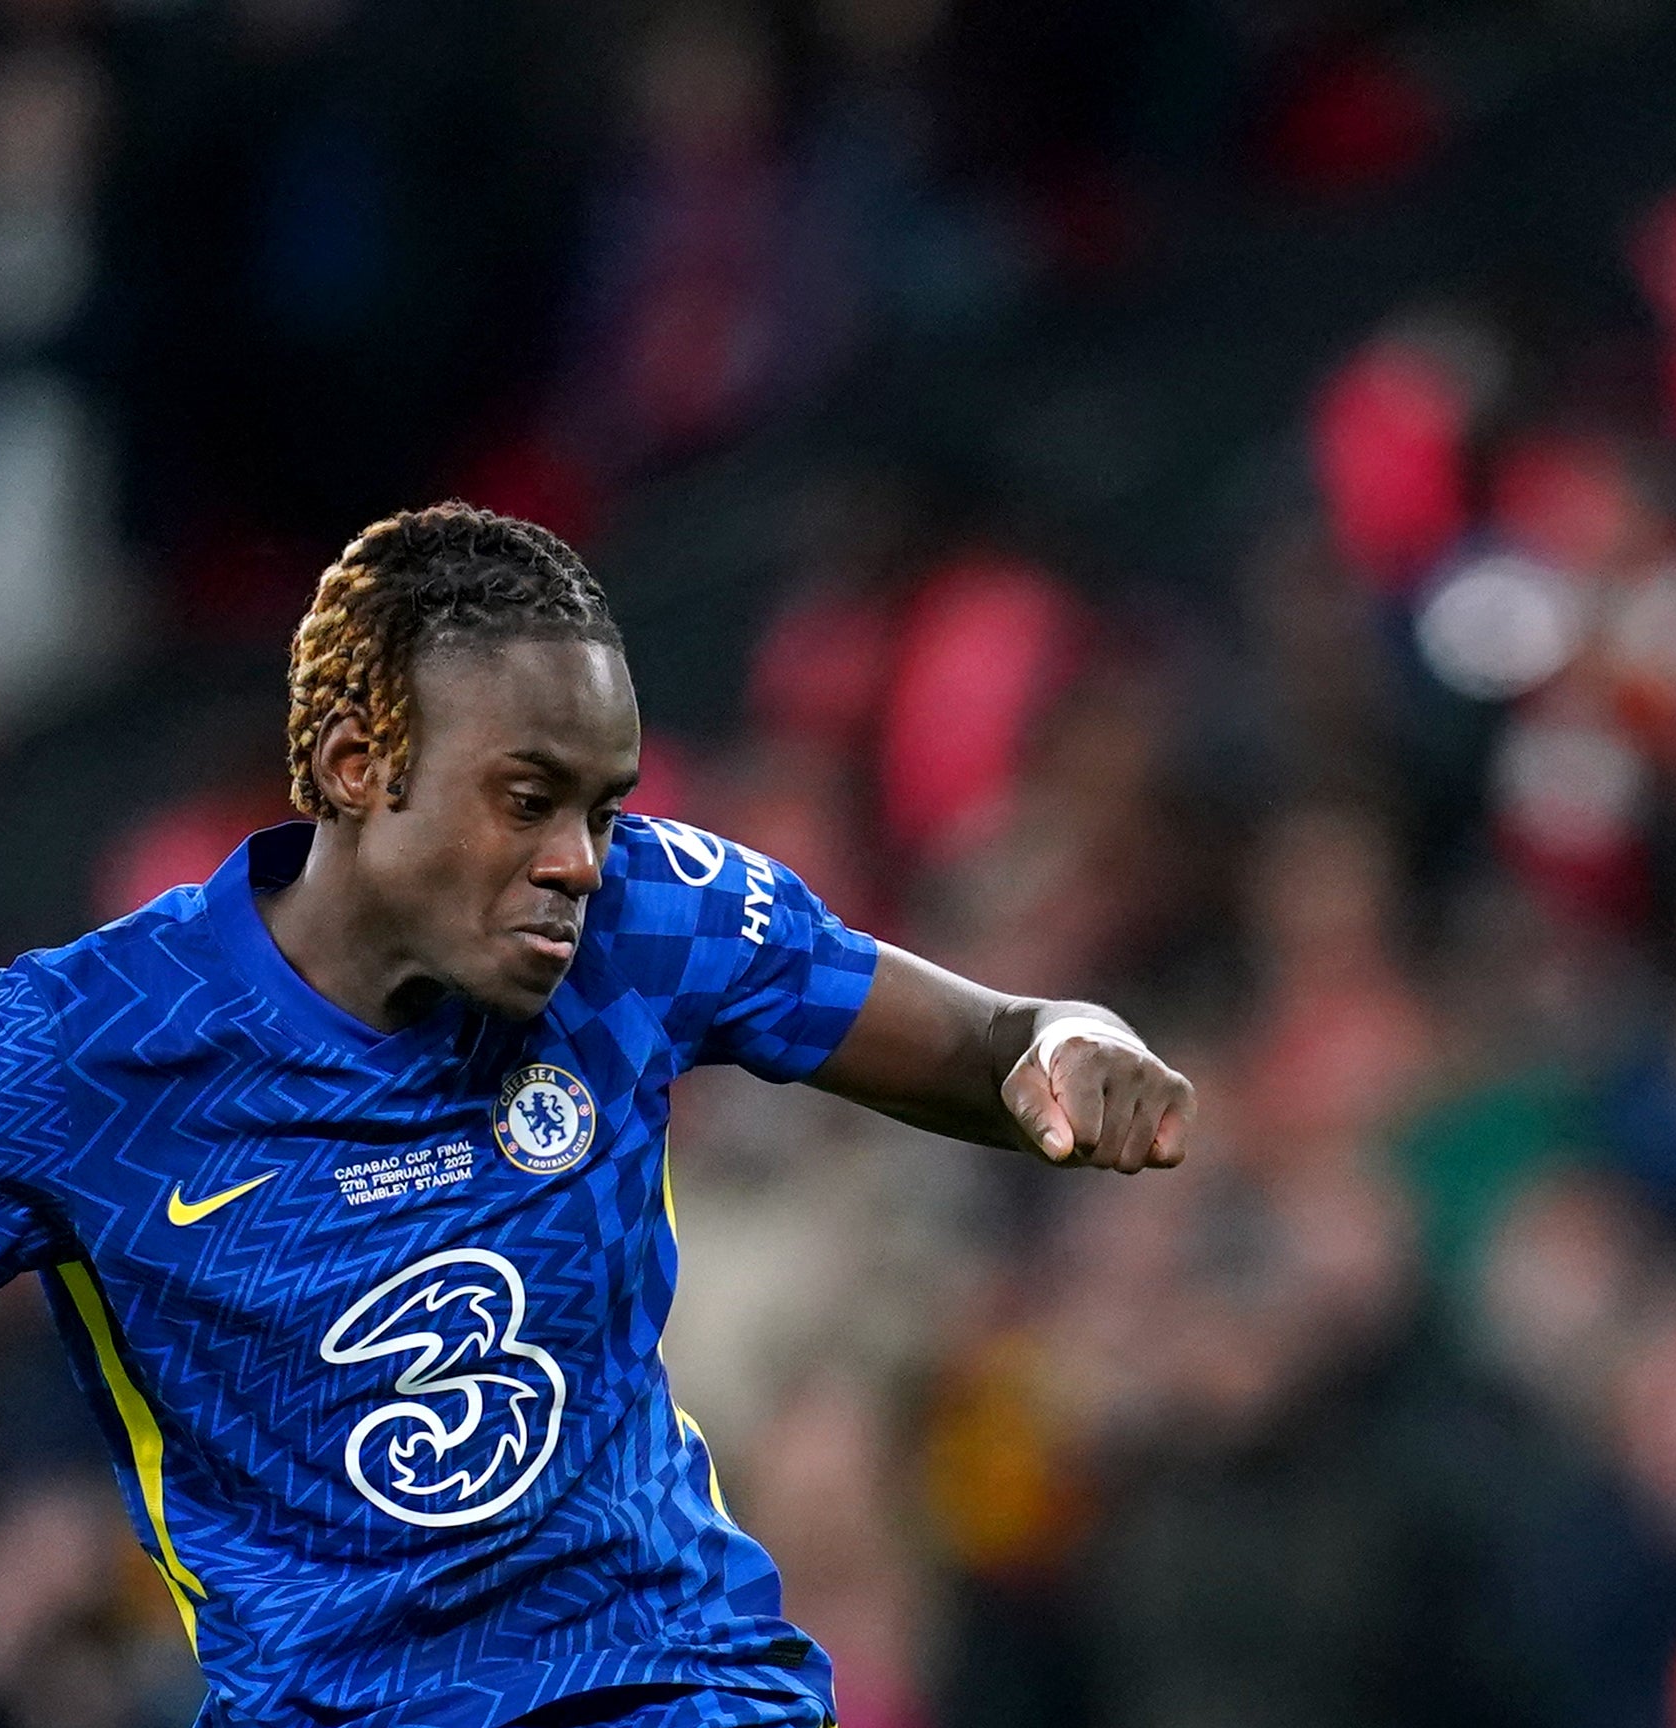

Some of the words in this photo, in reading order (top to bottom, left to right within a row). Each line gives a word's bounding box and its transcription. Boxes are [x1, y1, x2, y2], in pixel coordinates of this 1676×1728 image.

[500, 1069, 556, 1106] CHELSEA
[334, 1156, 400, 1181] CARABAO
[405, 1149, 432, 1165] CUP
[437, 1140, 474, 1158] FINAL
[527, 1152, 573, 1167] FOOTBALL
[572, 1130, 588, 1153] CLUB
[340, 1178, 368, 1193] 27th
[371, 1161, 438, 1187] FEBRUARY
[444, 1153, 473, 1169] 2022
[347, 1182, 409, 1206] WEMBLEY
[415, 1167, 473, 1191] STADIUM
